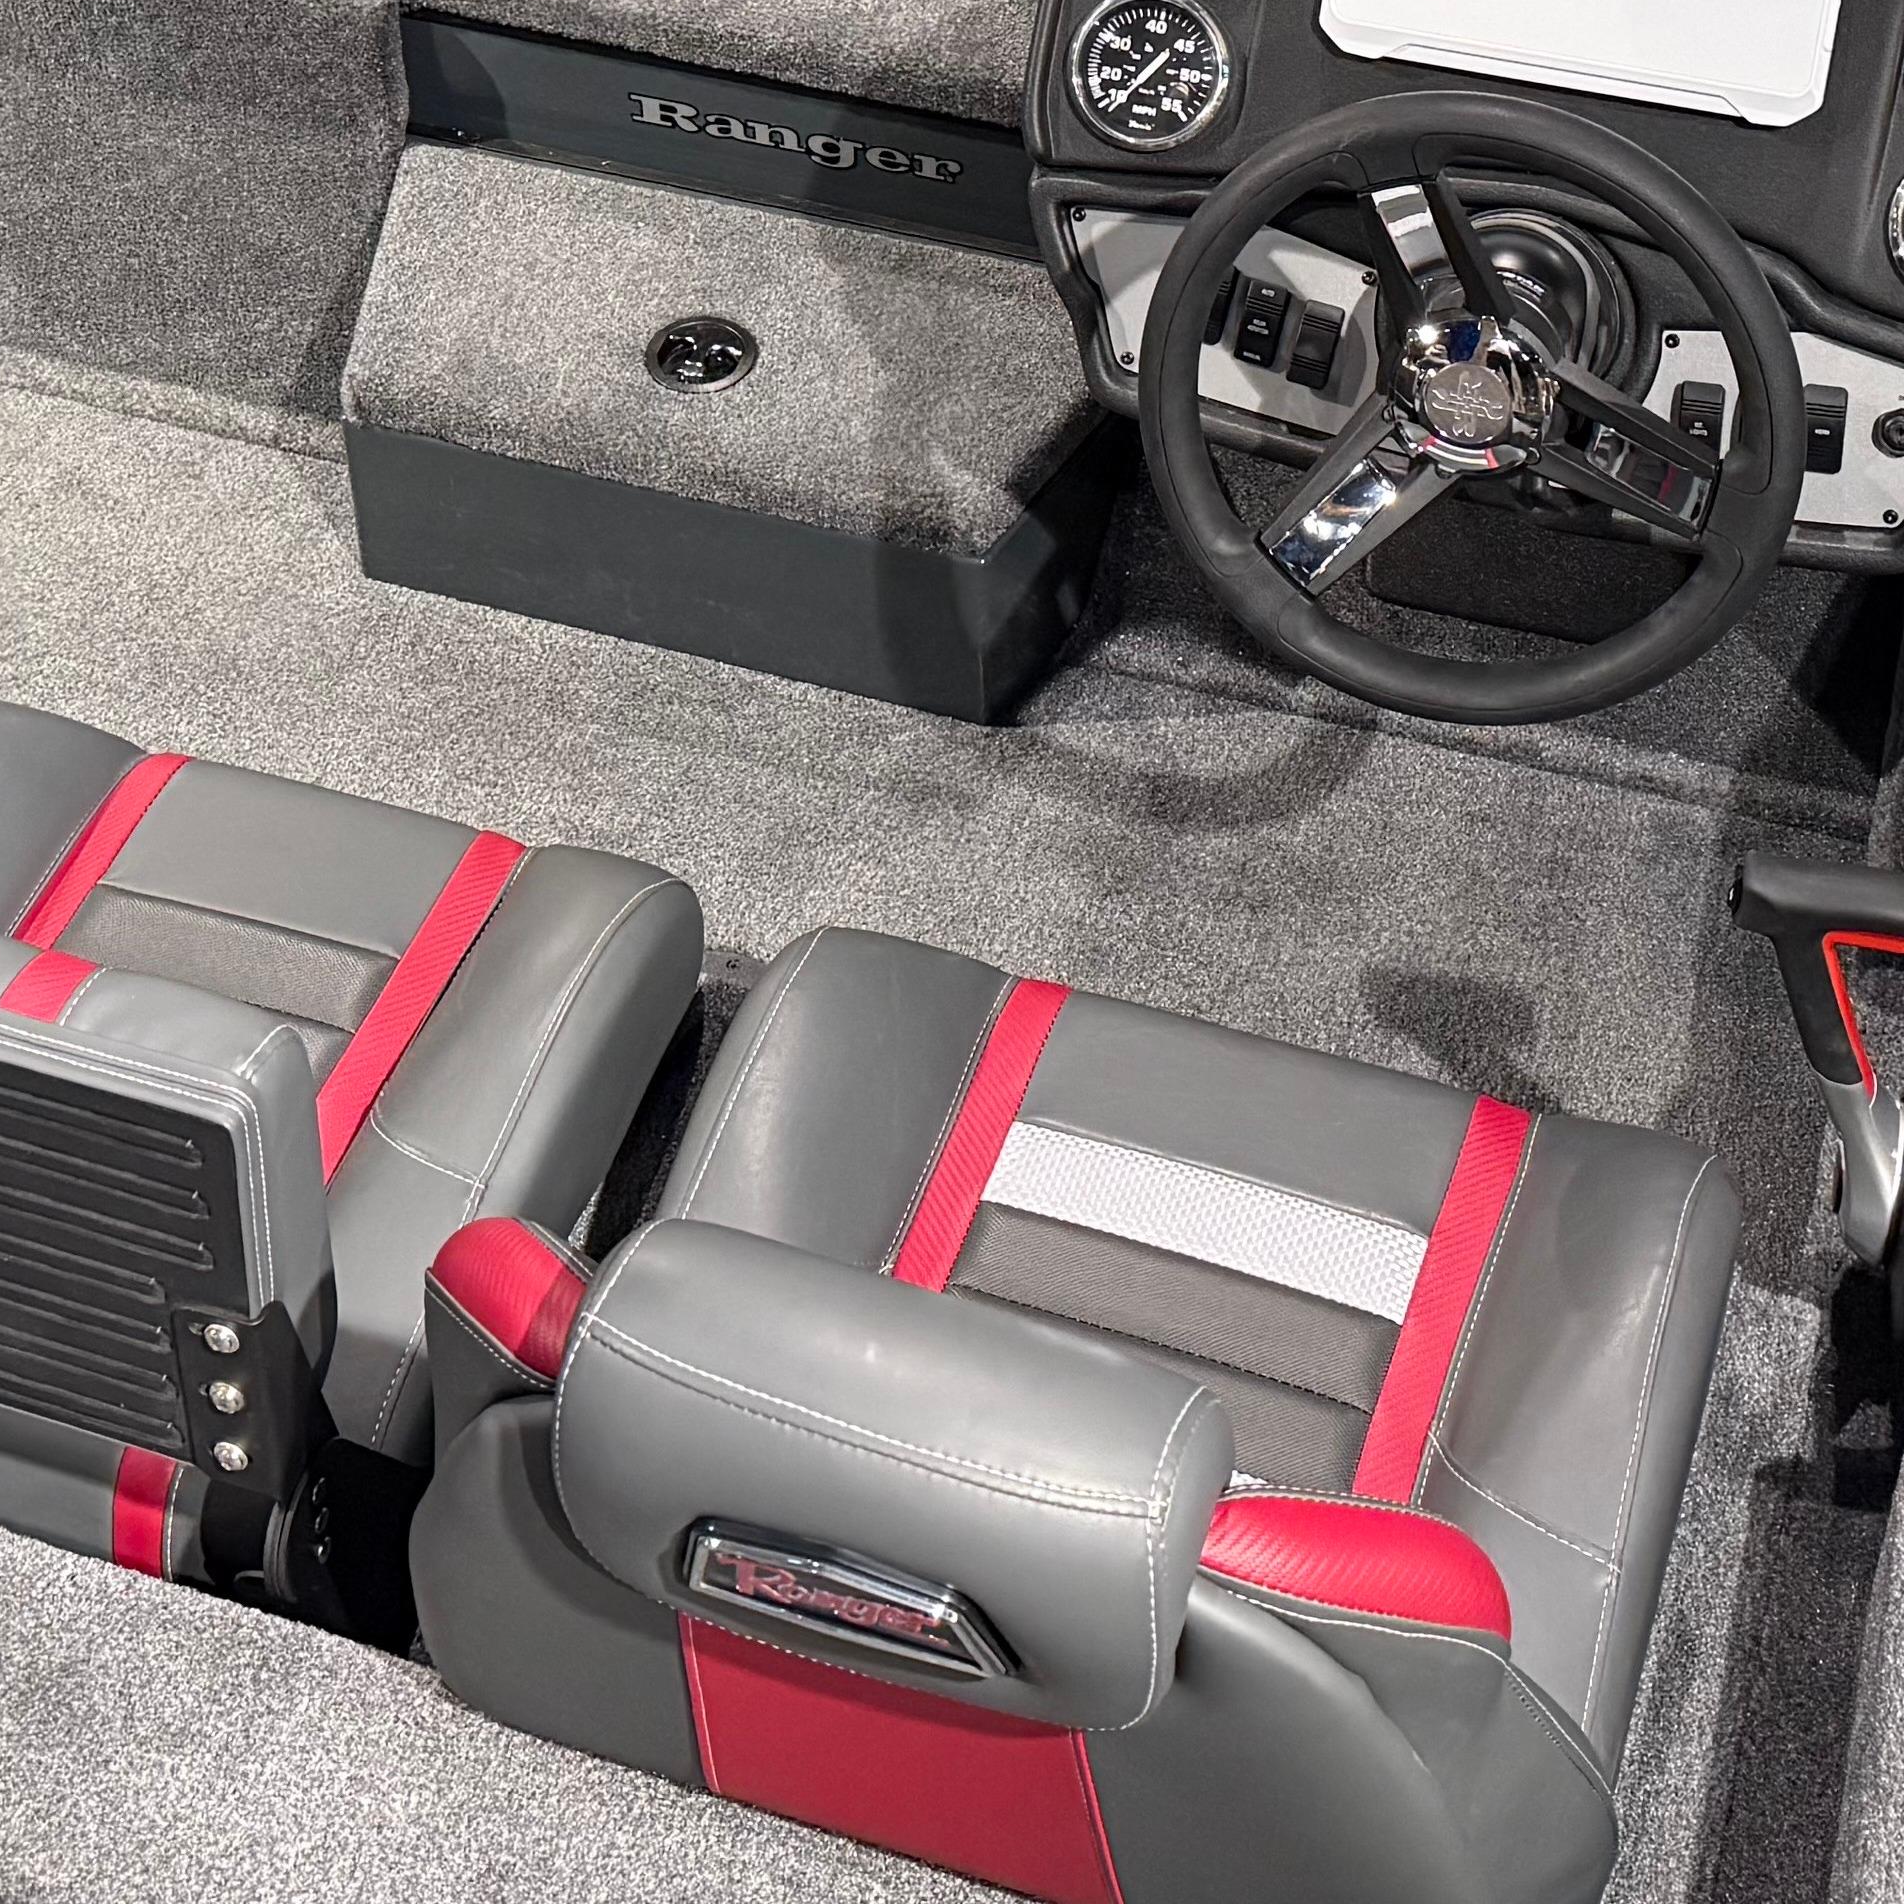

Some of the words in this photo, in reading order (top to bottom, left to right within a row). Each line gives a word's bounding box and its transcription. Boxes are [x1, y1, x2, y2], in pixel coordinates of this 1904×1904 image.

[1145, 20, 1167, 34] 40
[1109, 36, 1132, 51] 30
[1173, 39, 1196, 54] 45
[1100, 66, 1122, 81] 20
[1179, 67, 1201, 83] 50
[1161, 97, 1183, 112] 55
[628, 92, 964, 185] Ranger
[716, 1552, 941, 1632] Ranger
